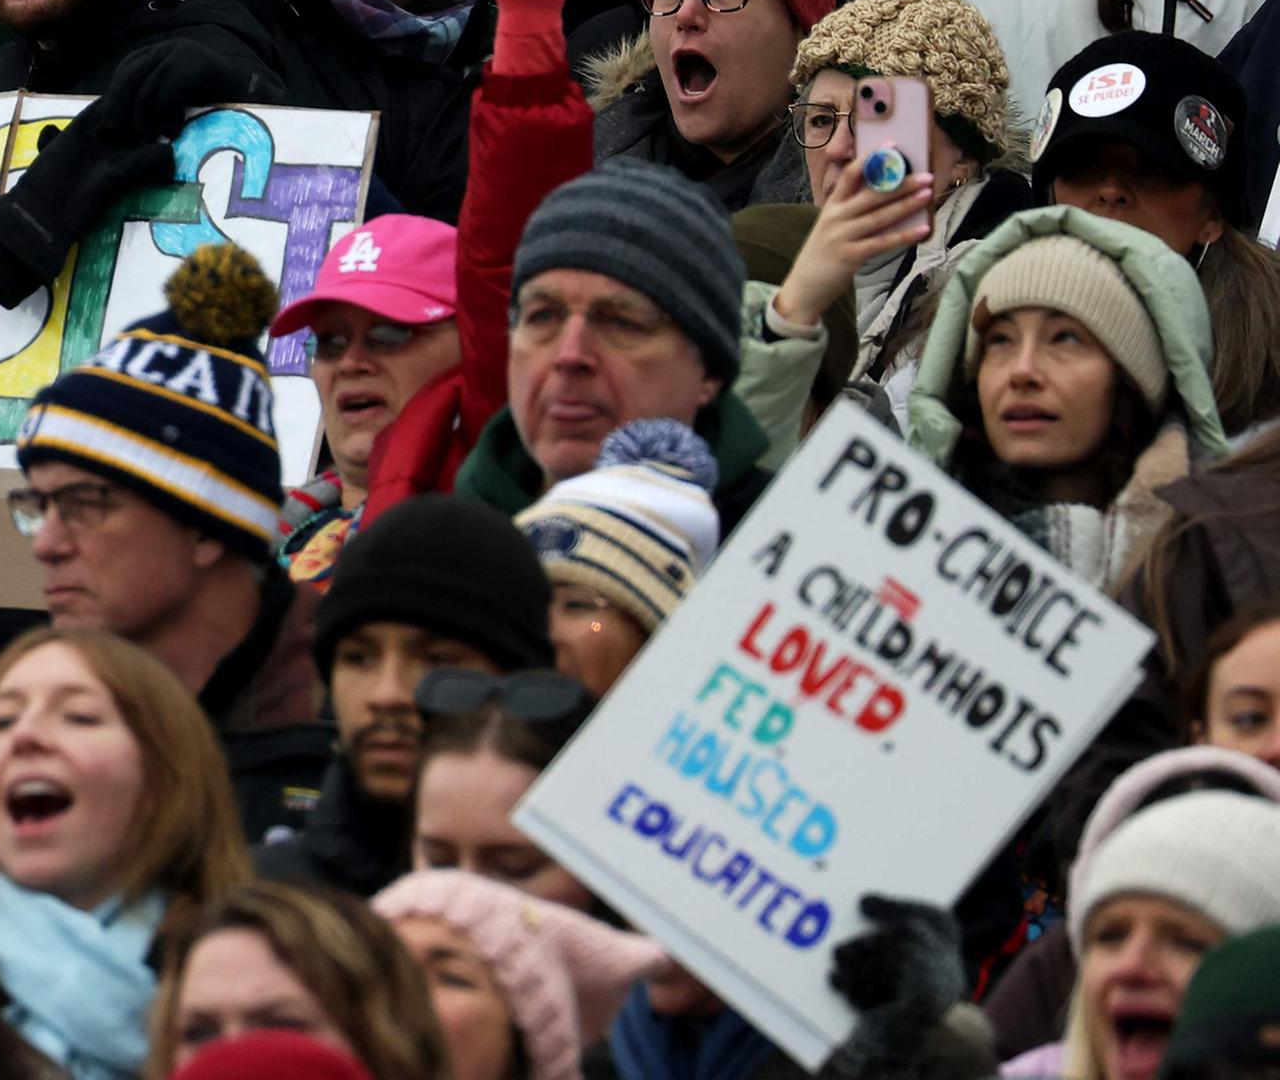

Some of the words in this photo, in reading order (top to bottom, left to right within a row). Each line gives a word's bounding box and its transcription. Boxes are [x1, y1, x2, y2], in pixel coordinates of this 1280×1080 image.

[1092, 87, 1135, 104] PUEDE!
[1183, 117, 1221, 159] MARCH
[339, 231, 382, 273] LA
[752, 528, 794, 578] A
[817, 433, 1107, 680] PRO-CHOICE
[606, 782, 834, 950] EDUCATED
